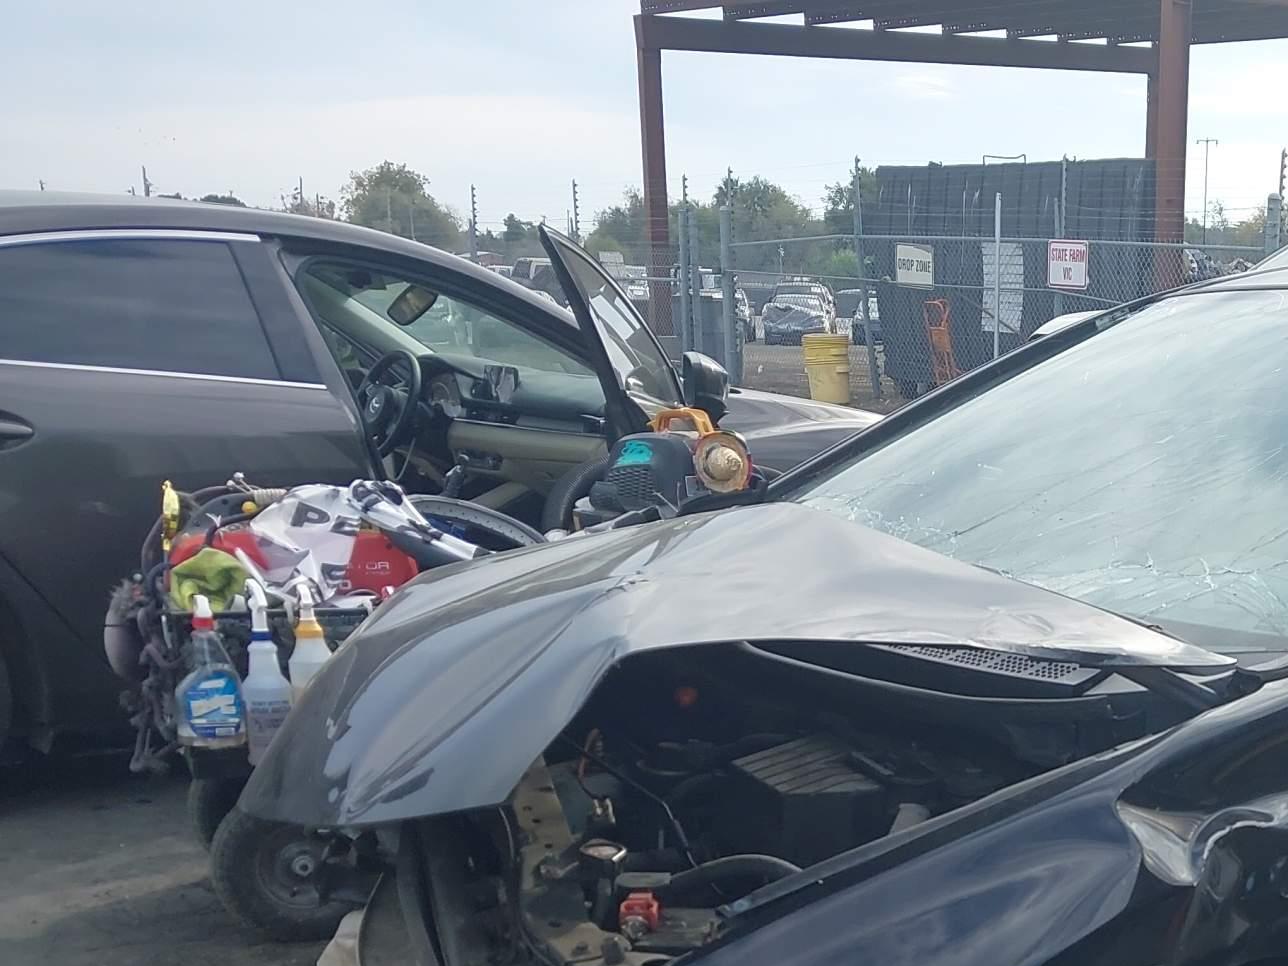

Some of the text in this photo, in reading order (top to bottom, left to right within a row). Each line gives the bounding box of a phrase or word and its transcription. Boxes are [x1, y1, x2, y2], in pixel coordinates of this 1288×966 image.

[1051, 247, 1086, 262] STATE FARM
[897, 258, 931, 273] DROP ZONE
